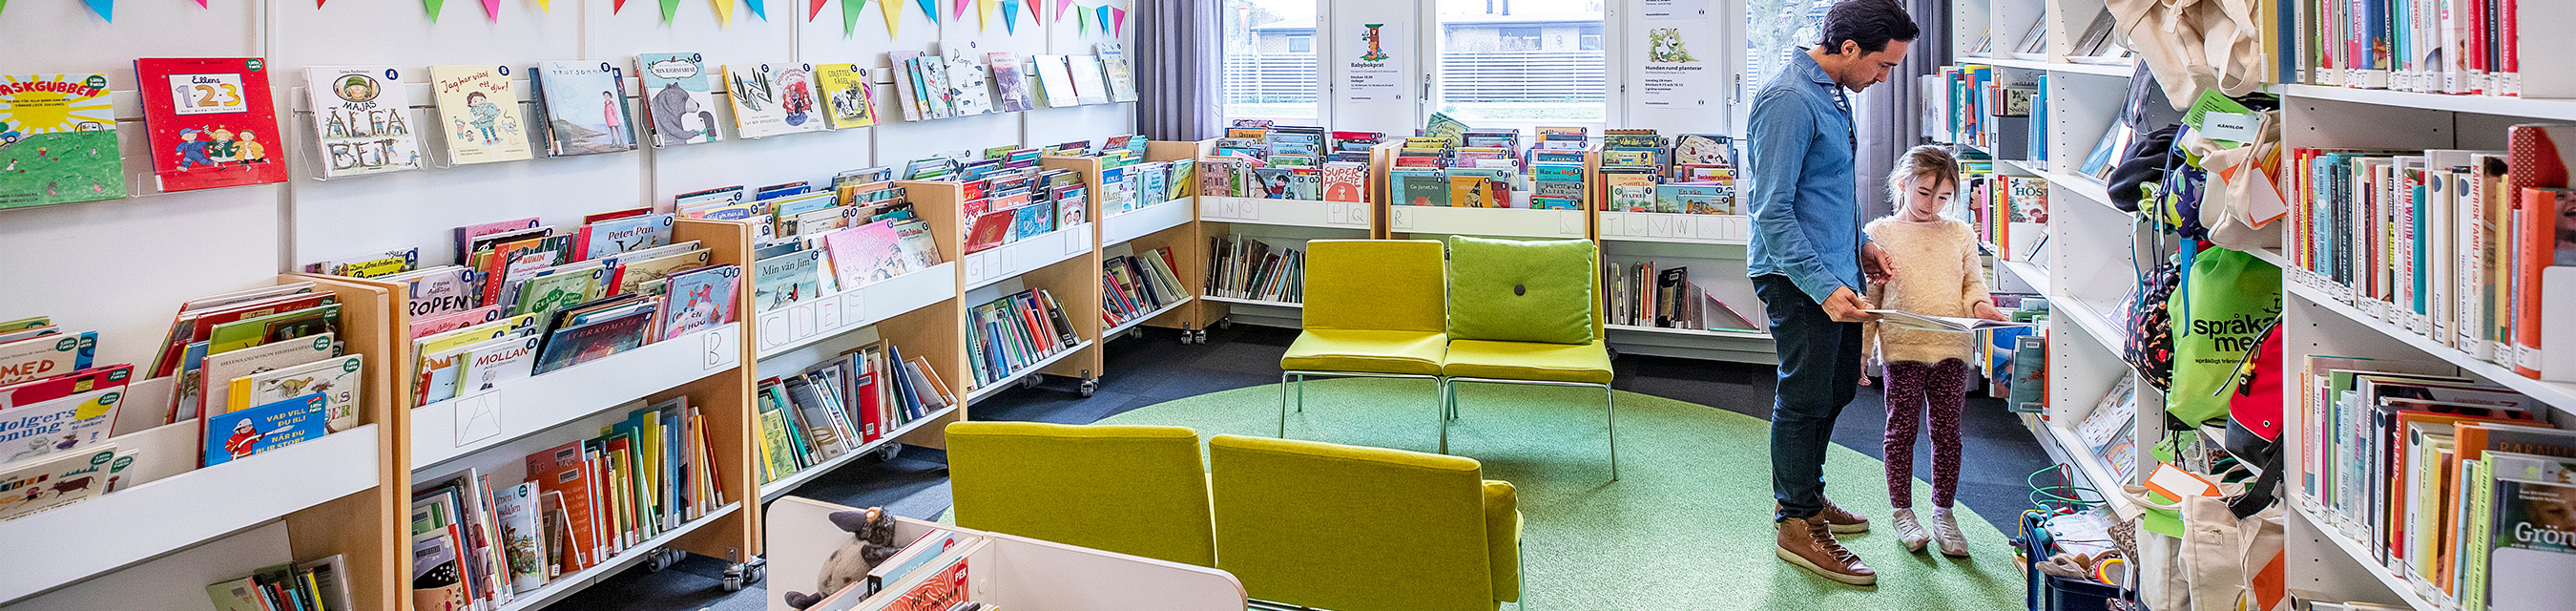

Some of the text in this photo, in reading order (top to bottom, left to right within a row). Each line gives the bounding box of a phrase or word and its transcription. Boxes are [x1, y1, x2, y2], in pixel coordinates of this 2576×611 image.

[192, 75, 220, 84] Ellens
[343, 101, 377, 112] MAJAS
[1324, 166, 1361, 179] SUPER
[2471, 164, 2480, 223] KÄRNFRISK
[608, 225, 654, 241] Peter Pan
[1608, 218, 1617, 235] T
[1652, 218, 1668, 234] V
[1676, 219, 1689, 235] W
[2471, 224, 2480, 259] FAMILJ
[762, 258, 810, 277] Min vän Jim
[409, 295, 468, 317] ROPEN
[824, 303, 834, 327] E
[765, 316, 783, 346] C
[266, 408, 306, 423] VAD VILL
[278, 415, 306, 428] DU BLI
[292, 430, 305, 438] DU
